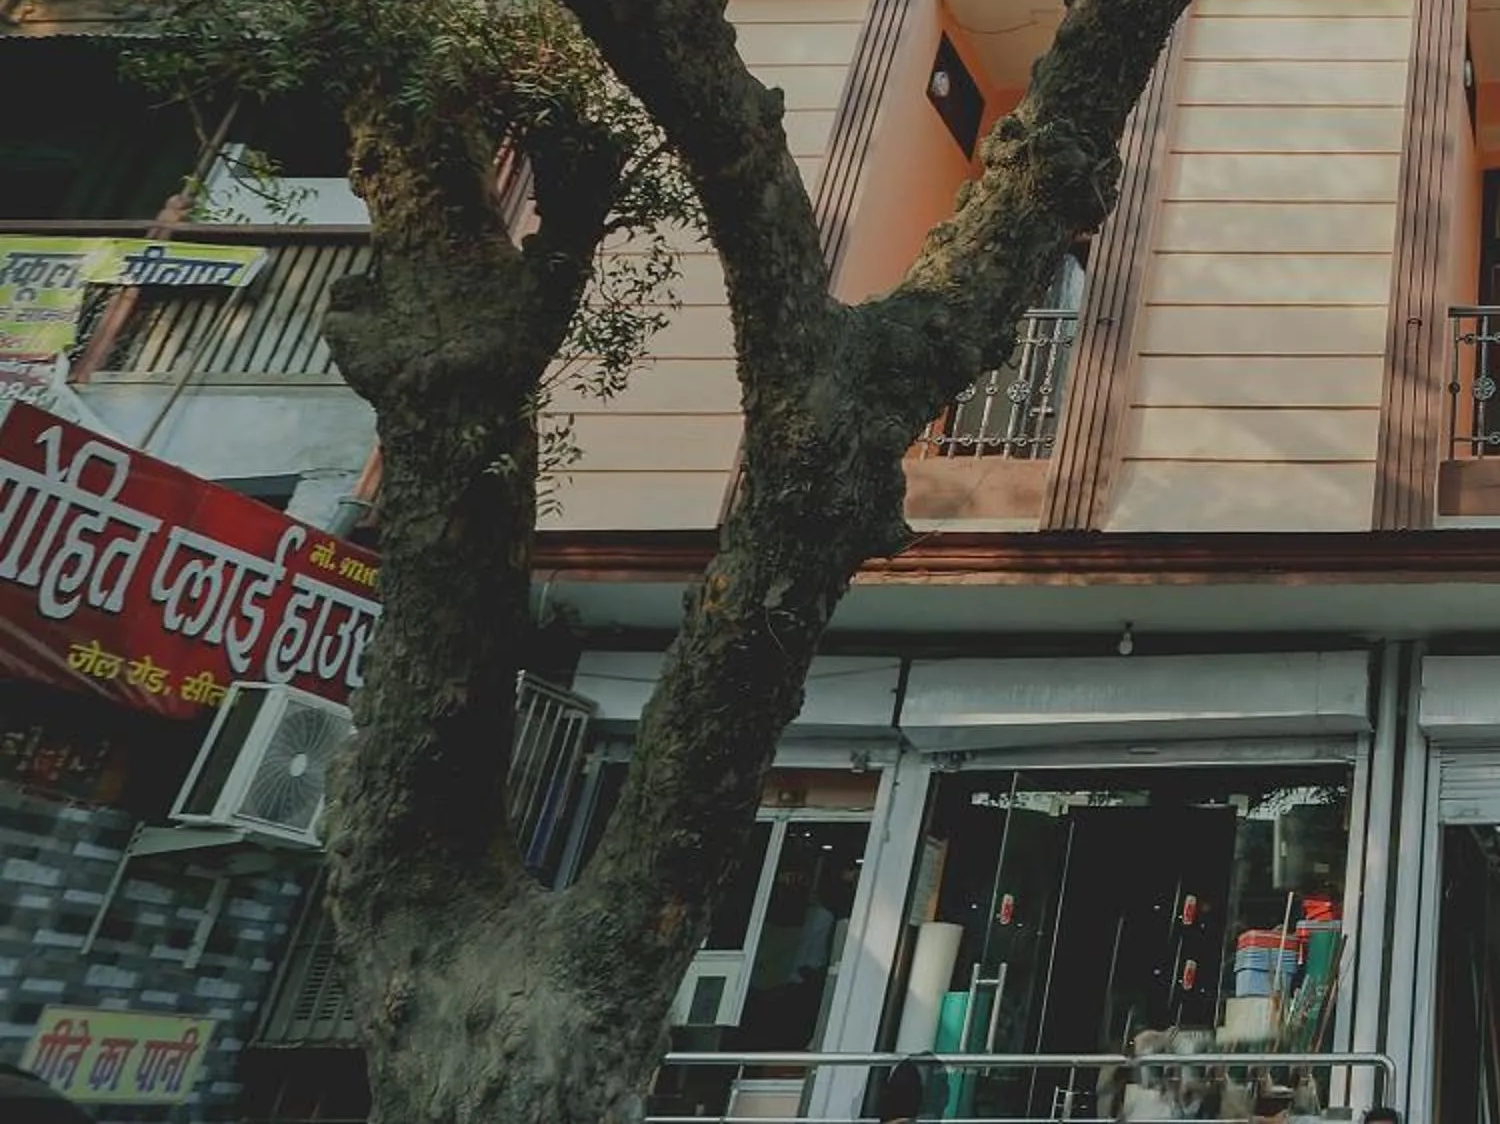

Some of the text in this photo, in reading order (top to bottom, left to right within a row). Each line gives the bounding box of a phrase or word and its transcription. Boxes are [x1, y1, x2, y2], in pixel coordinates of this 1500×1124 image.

[151, 525, 306, 674] प्लाई
[67, 639, 122, 680] जेल
[88, 1038, 139, 1091] का
[137, 1027, 199, 1092] पानी
